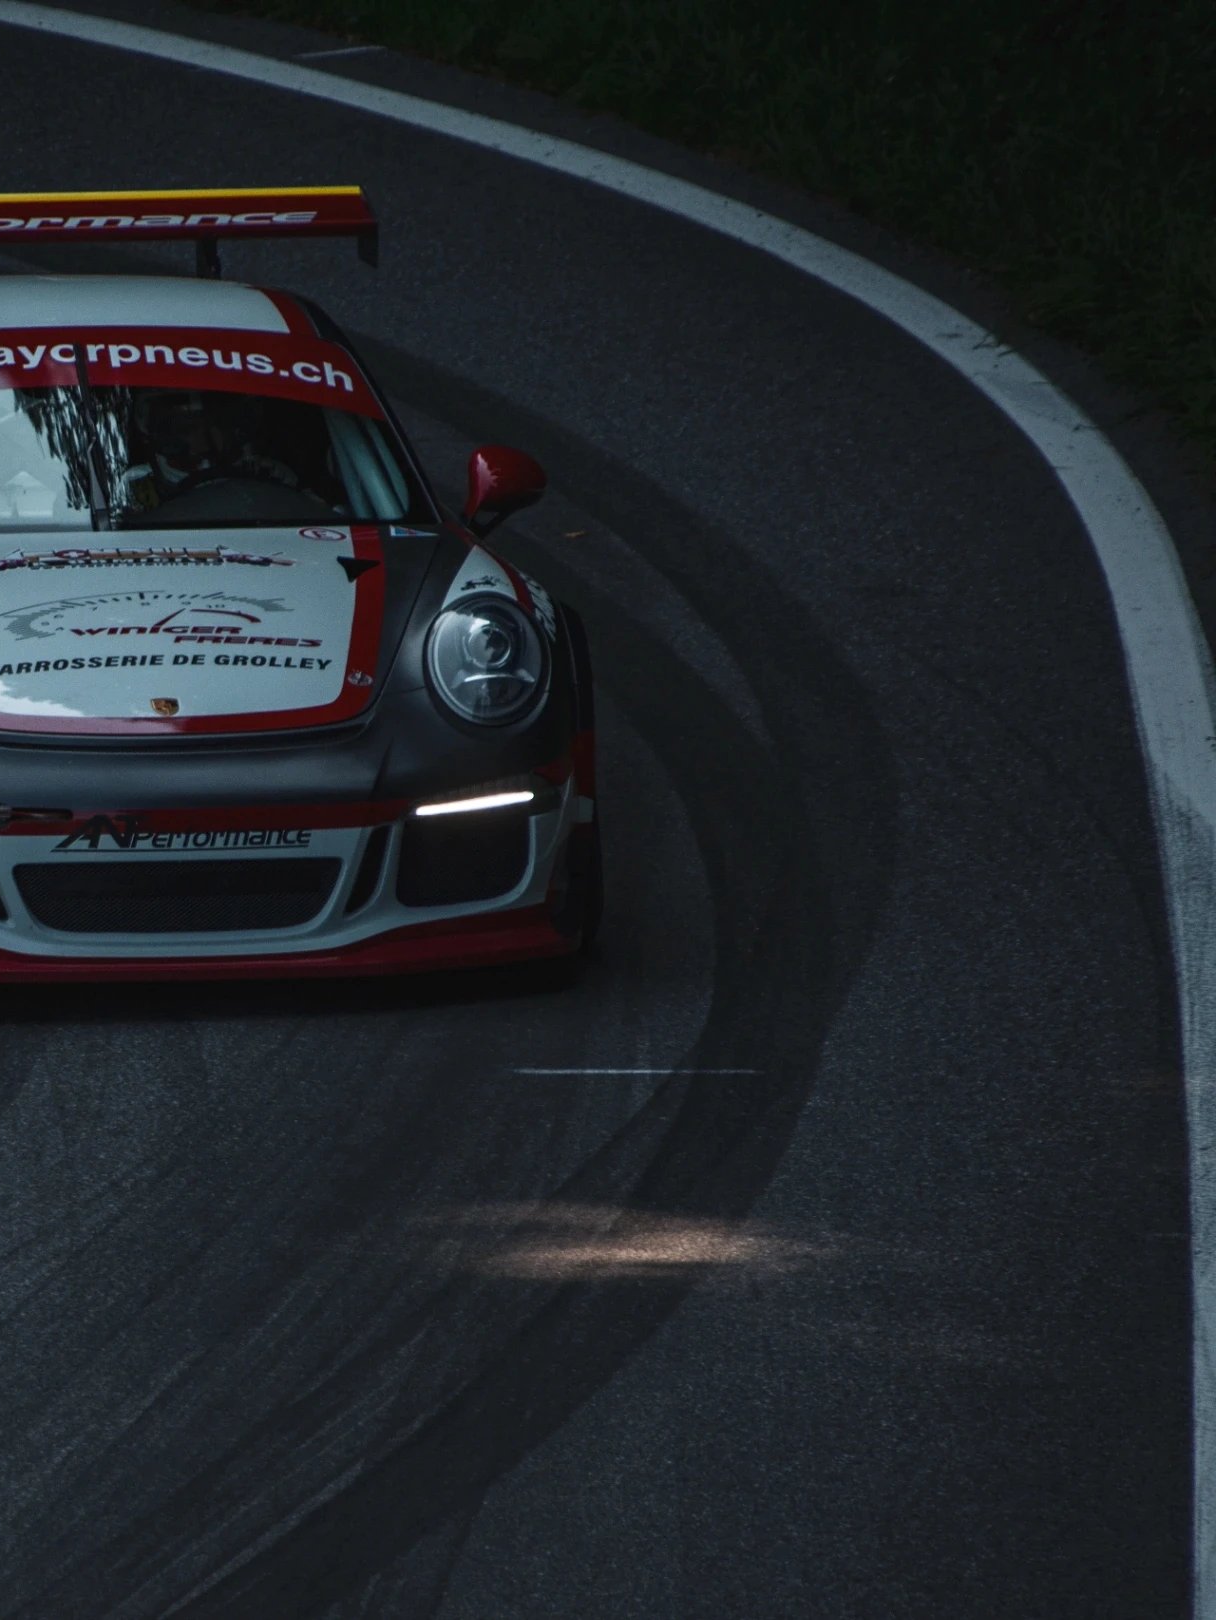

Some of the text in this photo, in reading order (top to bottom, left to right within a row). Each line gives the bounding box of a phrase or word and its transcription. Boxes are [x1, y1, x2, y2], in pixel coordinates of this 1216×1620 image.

[174, 635, 323, 648] FRERES
[172, 654, 206, 666] DE
[214, 654, 333, 671] GROLLEY
